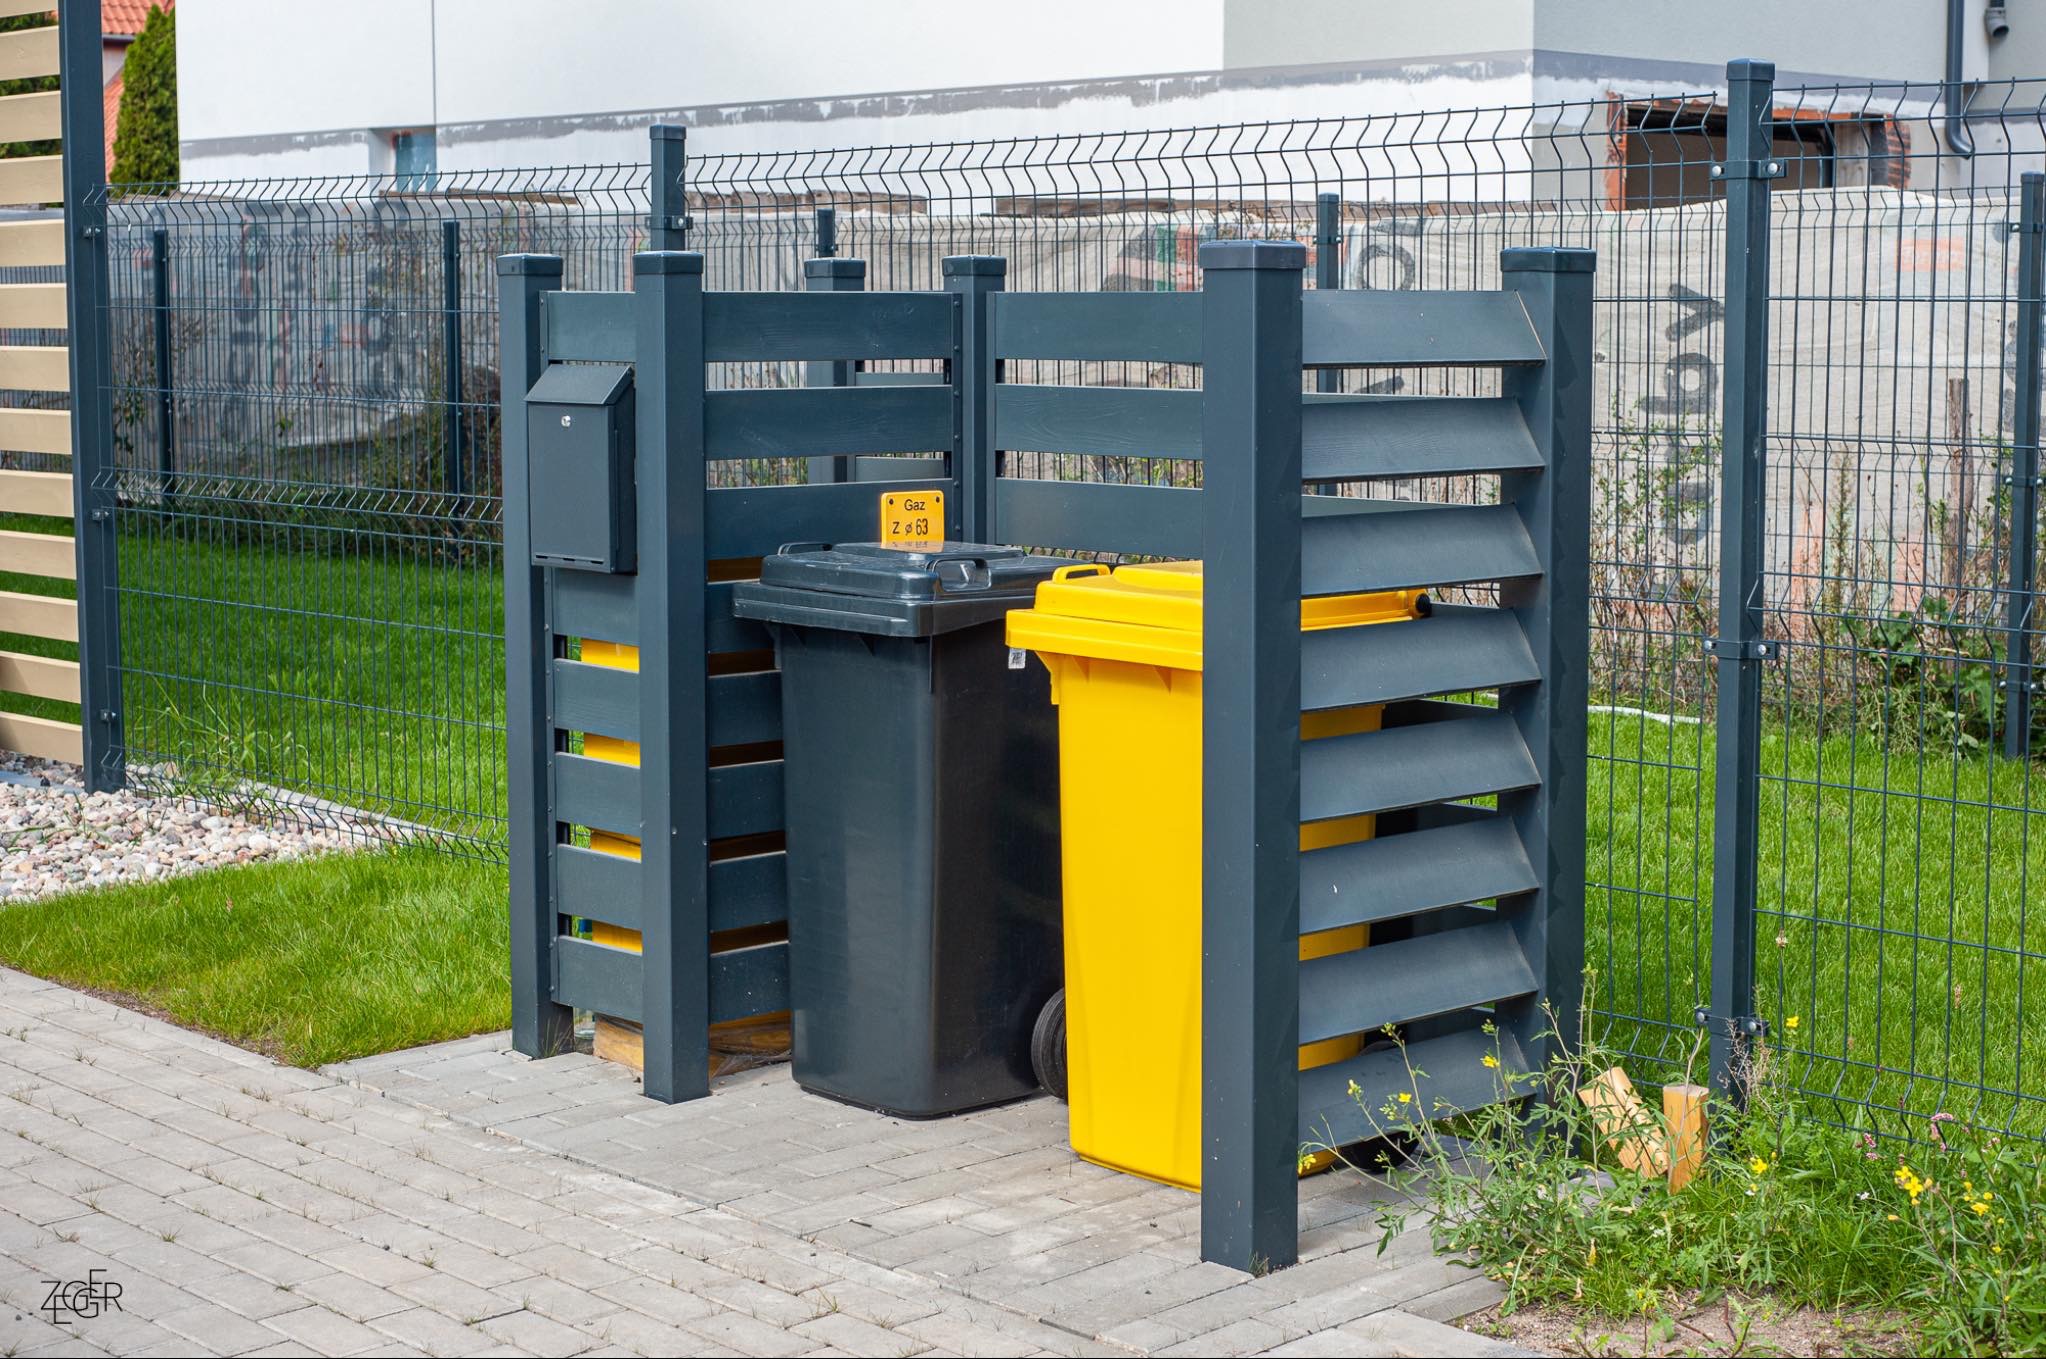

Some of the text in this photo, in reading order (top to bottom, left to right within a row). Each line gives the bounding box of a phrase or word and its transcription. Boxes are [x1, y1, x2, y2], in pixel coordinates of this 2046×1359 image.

[904, 498, 926, 511] Gaz
[892, 521, 900, 535] Z
[915, 518, 929, 536] 63
